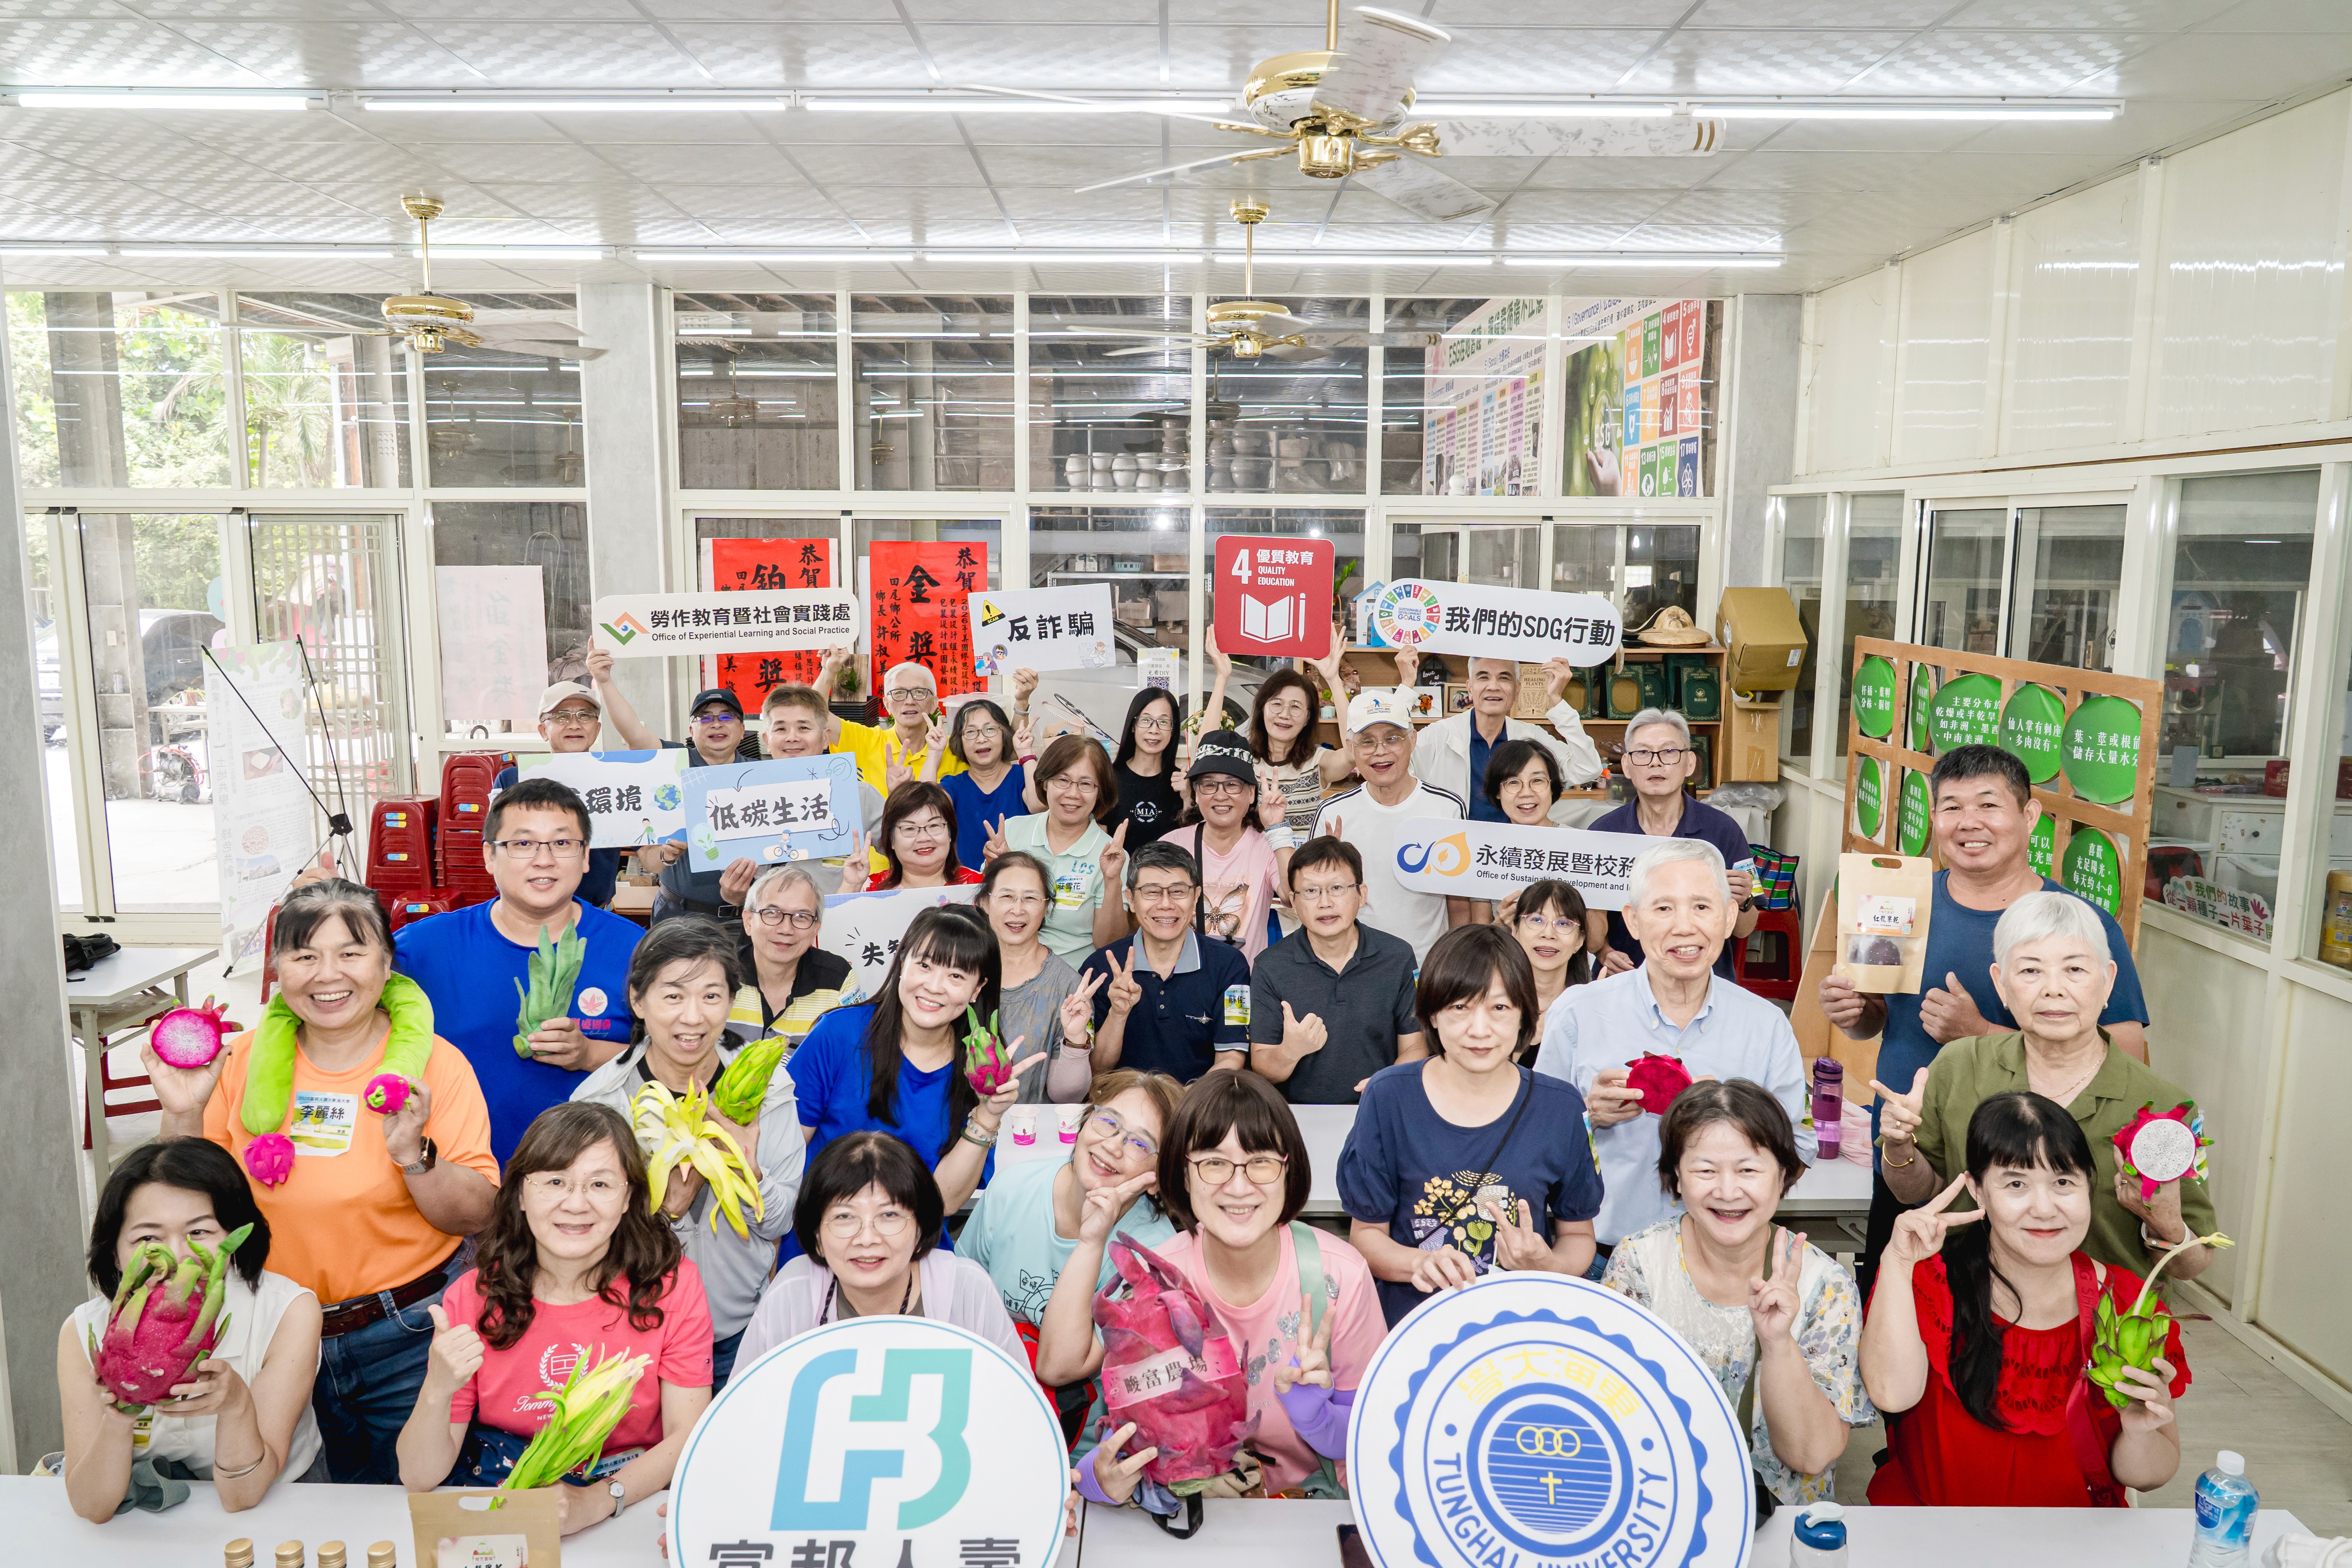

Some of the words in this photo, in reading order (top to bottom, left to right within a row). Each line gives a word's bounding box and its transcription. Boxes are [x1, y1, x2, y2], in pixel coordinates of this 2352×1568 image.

[1683, 302, 1687, 317] 5
[1663, 312, 1666, 325] 4
[1627, 329, 1630, 341] 2
[1644, 321, 1647, 334] 3
[1661, 383, 1664, 396] 8
[1626, 395, 1629, 407] 6
[1595, 423, 1610, 447] ESG
[1660, 446, 1664, 459] 15
[1680, 443, 1685, 457] 17
[1641, 452, 1646, 465] 13
[798, 544, 824, 588] 恭賀
[955, 547, 979, 593] 恭賀
[1232, 549, 1252, 584] 4
[1256, 548, 1314, 566] 優質教育
[1258, 566, 1286, 575] QUALITY
[1258, 577, 1294, 587] EDUCATION
[651, 603, 850, 628] 勞作教育暨社會實踐處
[890, 578, 902, 642] 田尾鄉公所
[987, 615, 999, 624] SCAM
[1007, 611, 1094, 642] 反詐騙
[1445, 606, 1615, 647] 我們的SDG行動
[652, 632, 676, 641] Office
[678, 632, 686, 640] of
[688, 629, 736, 641] Experiential
[738, 628, 773, 638] Learning
[775, 628, 790, 636] and
[792, 627, 815, 636] Social
[818, 625, 849, 635] Practice
[2008, 717, 2061, 737] 仙人掌有刺座
[570, 785, 642, 814] 環境
[709, 792, 830, 831] 低碳生活
[1071, 860, 1095, 874] LCS
[1477, 870, 1499, 879] Office
[1501, 872, 1508, 880] of
[2195, 882, 2251, 913] 我們的故事
[300, 1105, 344, 1120] 李麗絲
[1433, 1452, 1519, 1568] TUNGHAI
[2198, 1495, 2220, 1514] Light
